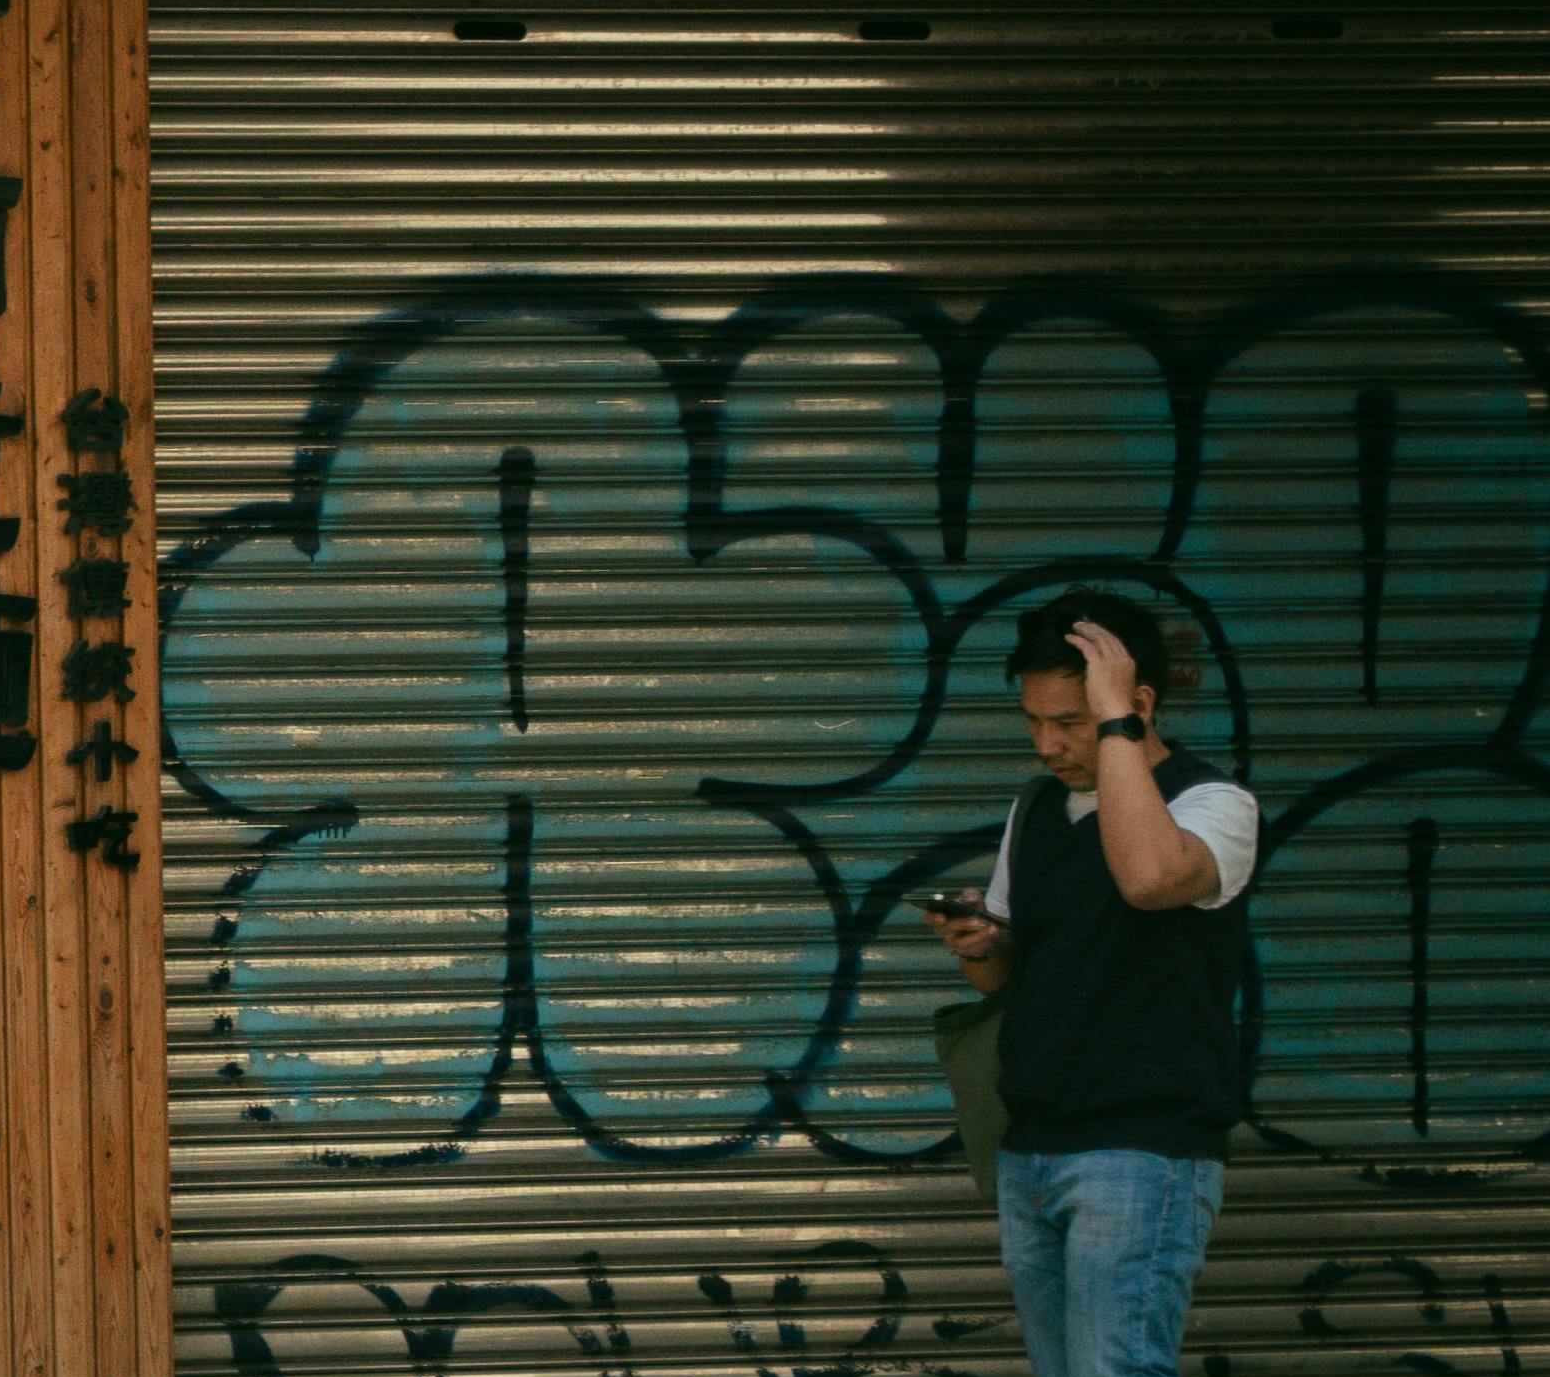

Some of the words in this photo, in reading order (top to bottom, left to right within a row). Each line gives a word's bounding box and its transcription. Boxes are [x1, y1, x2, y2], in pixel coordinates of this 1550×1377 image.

[55, 388, 141, 868] 台灣傳統小吃
